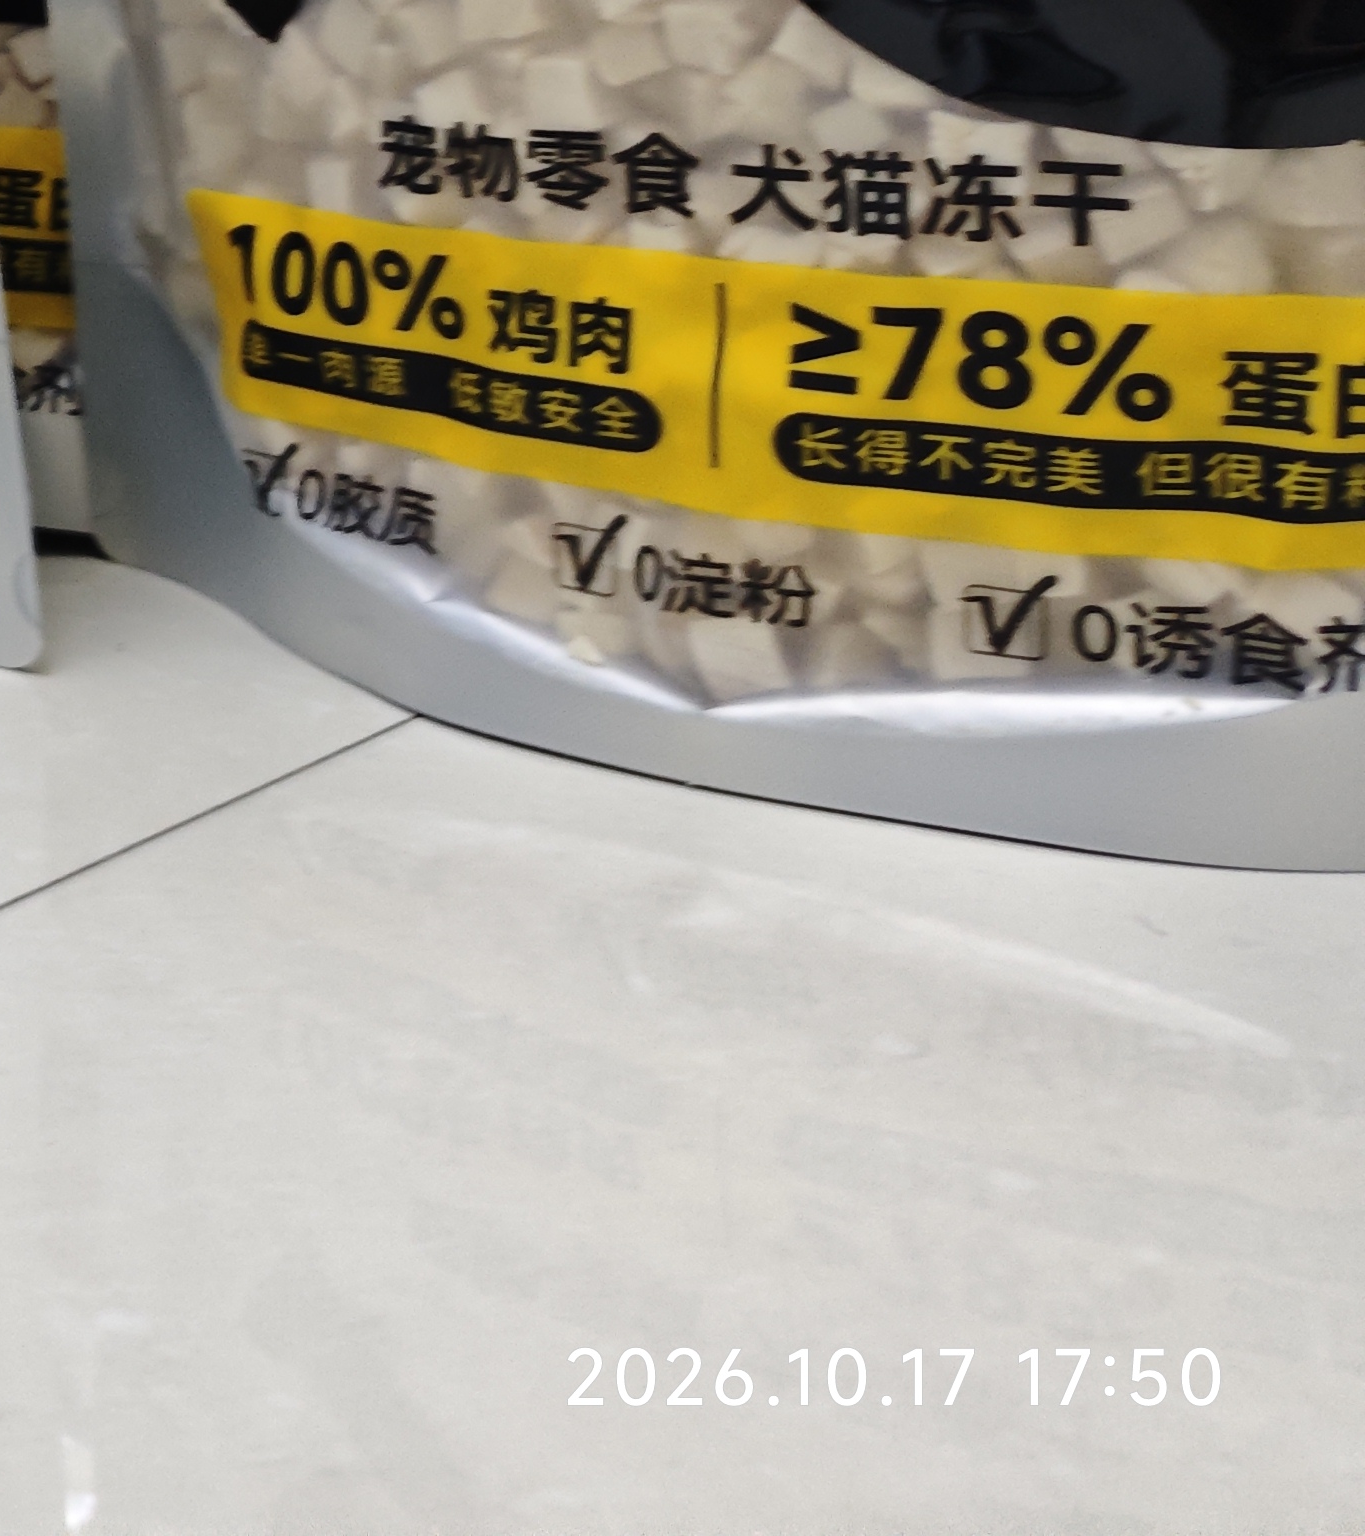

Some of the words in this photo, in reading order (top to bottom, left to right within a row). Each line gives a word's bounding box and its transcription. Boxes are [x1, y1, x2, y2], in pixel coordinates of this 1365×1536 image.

[379, 115, 699, 221] 宠物零食
[728, 142, 1132, 247] 犬猫冻干
[226, 224, 466, 341] 100%
[485, 289, 634, 375] 鸡肉
[788, 302, 1175, 423] ≥78%
[296, 468, 437, 556] 0胶质
[794, 423, 1106, 498] 长得不完美
[632, 543, 819, 628] 0淀粉
